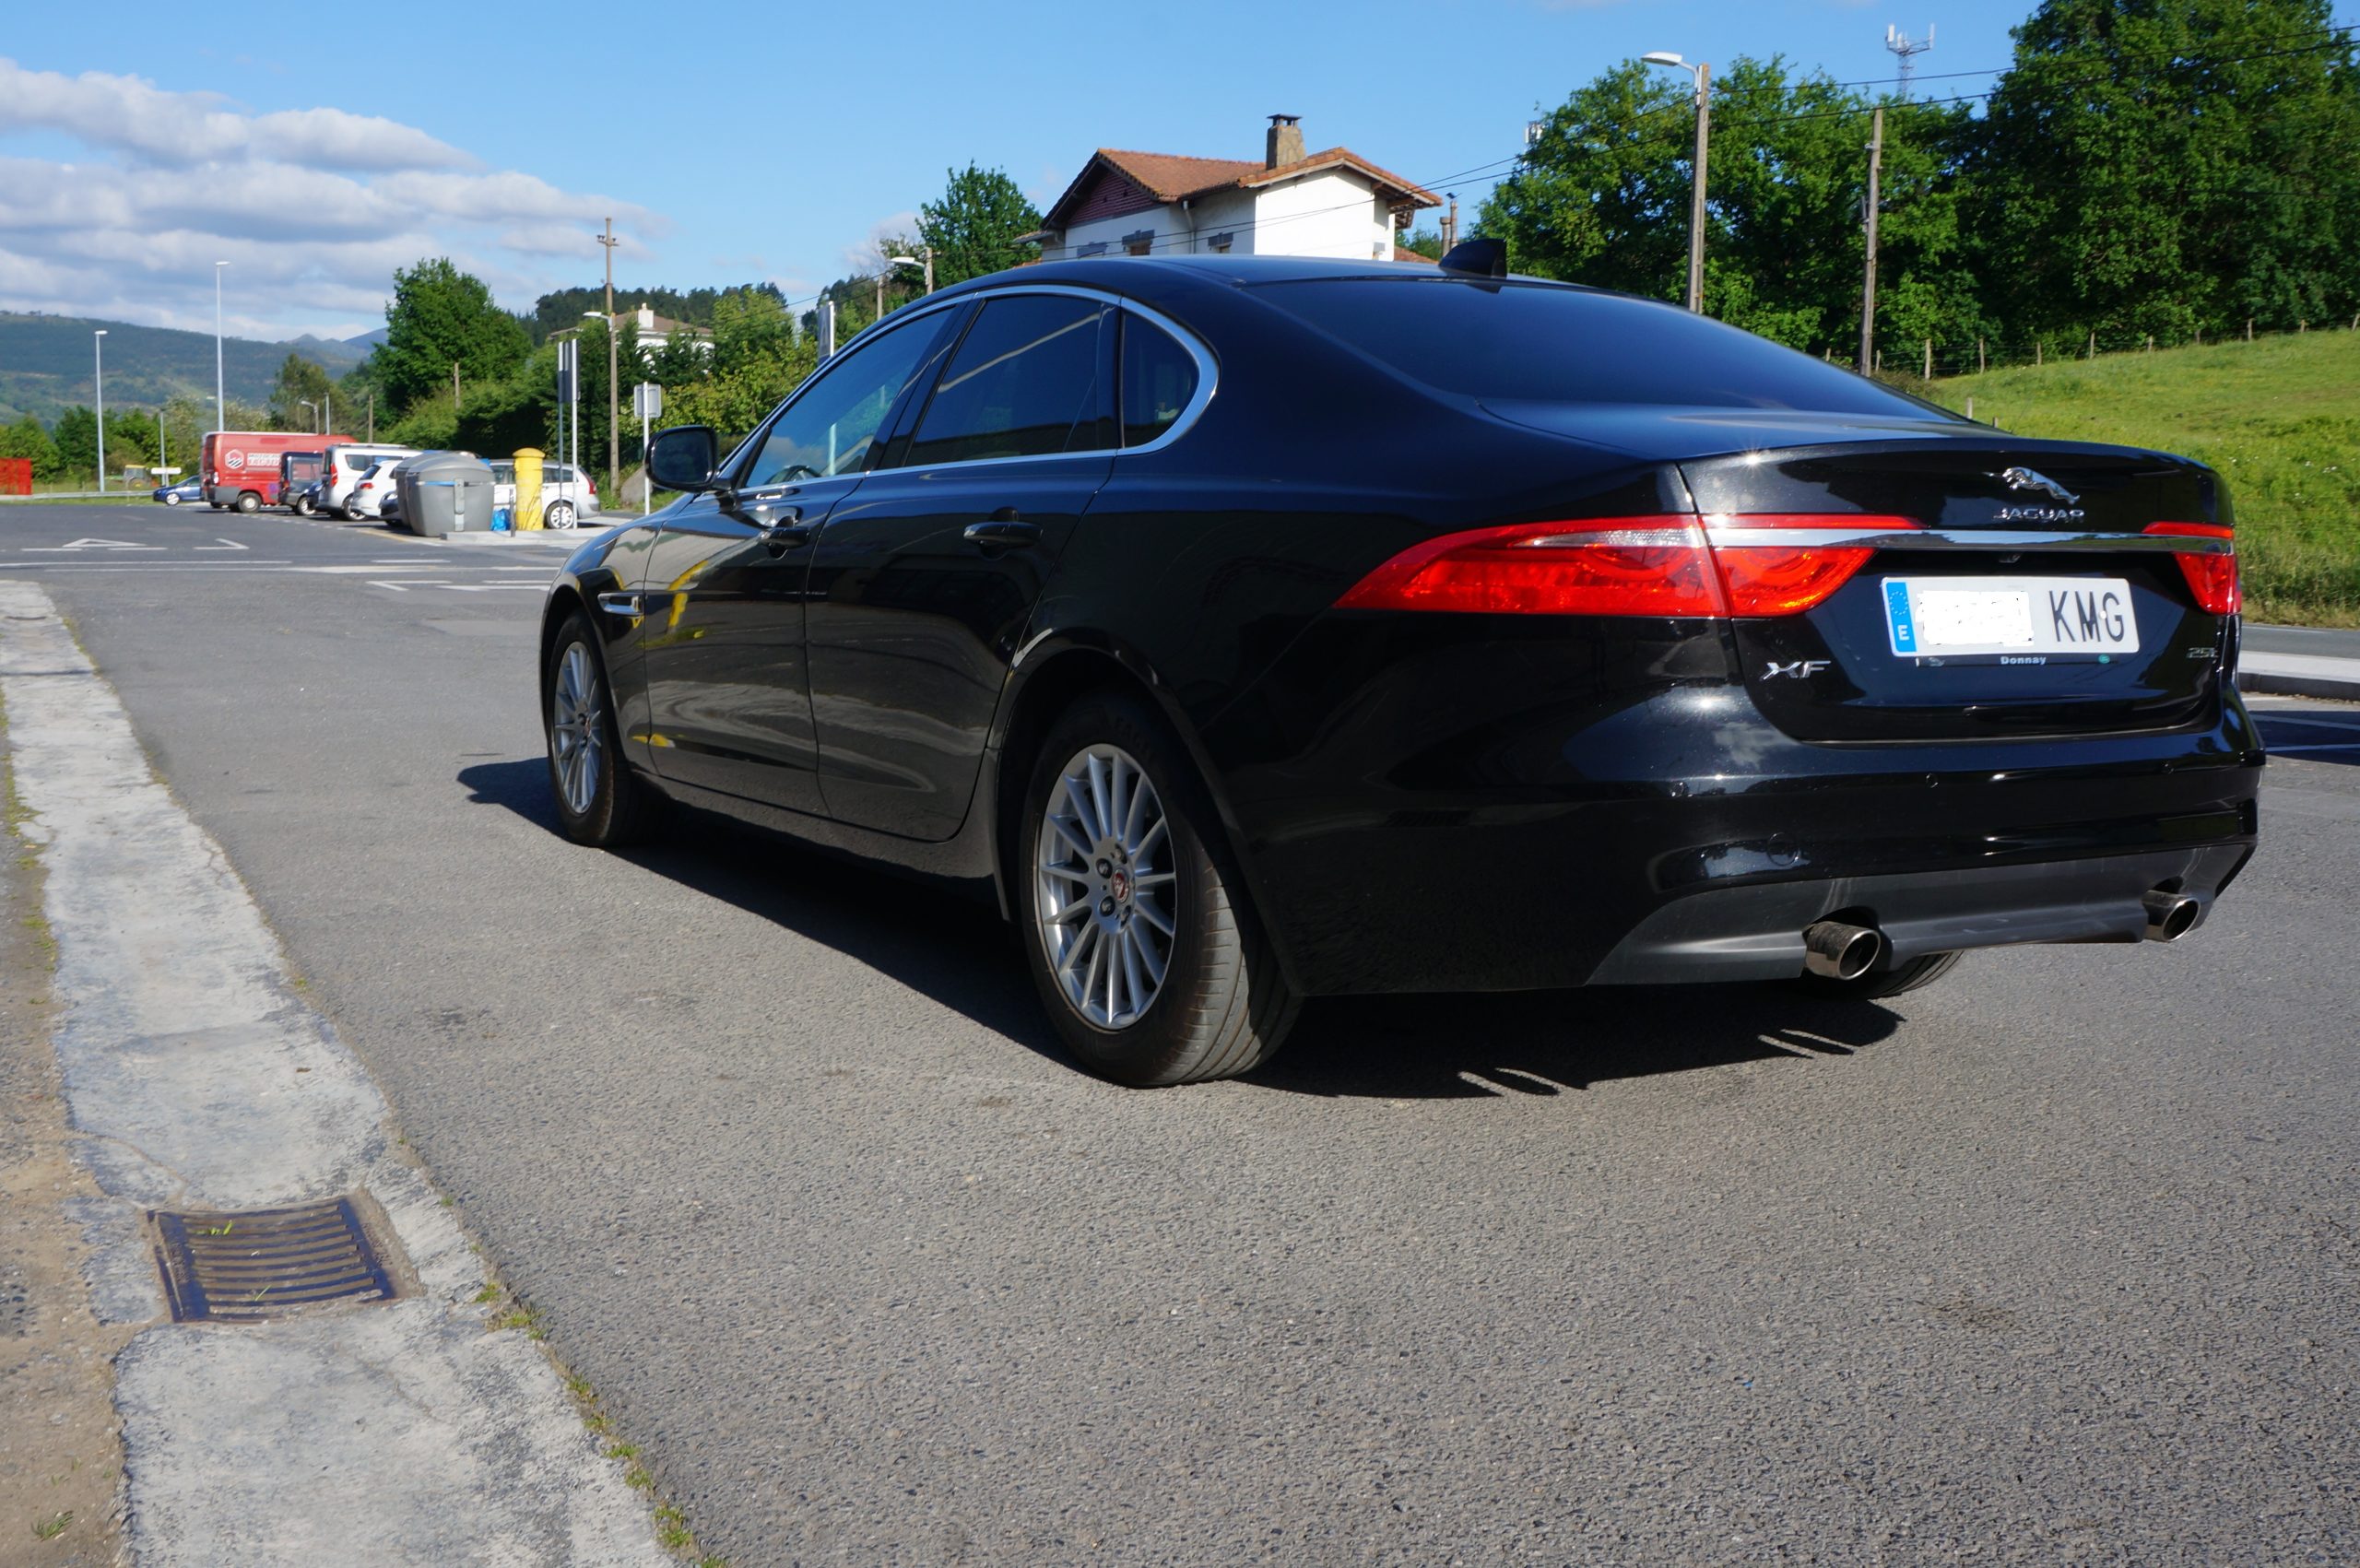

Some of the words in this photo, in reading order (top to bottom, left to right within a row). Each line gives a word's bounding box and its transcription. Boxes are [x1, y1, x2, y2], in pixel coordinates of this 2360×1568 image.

[1993, 508, 2084, 523] JAGUAR
[2048, 590, 2125, 643] KMG
[1897, 624, 1910, 641] E
[2000, 655, 2047, 666] Donnay
[1759, 661, 1831, 681] XF
